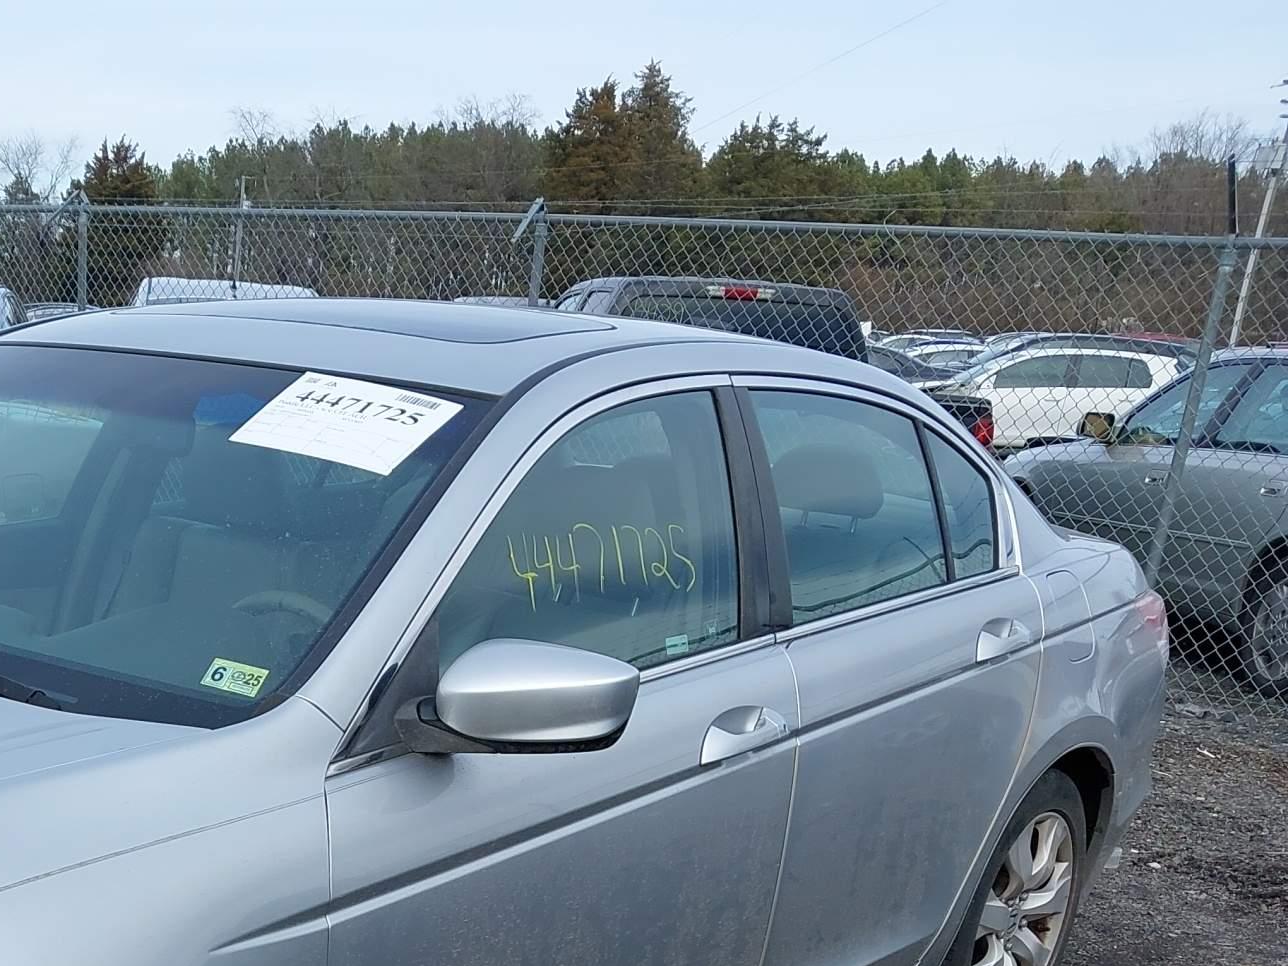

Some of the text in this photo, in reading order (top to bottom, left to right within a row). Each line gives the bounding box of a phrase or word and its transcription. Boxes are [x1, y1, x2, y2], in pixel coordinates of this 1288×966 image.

[296, 390, 426, 426] 44471725
[506, 523, 697, 613] 44471725
[211, 666, 263, 687] 6 25
